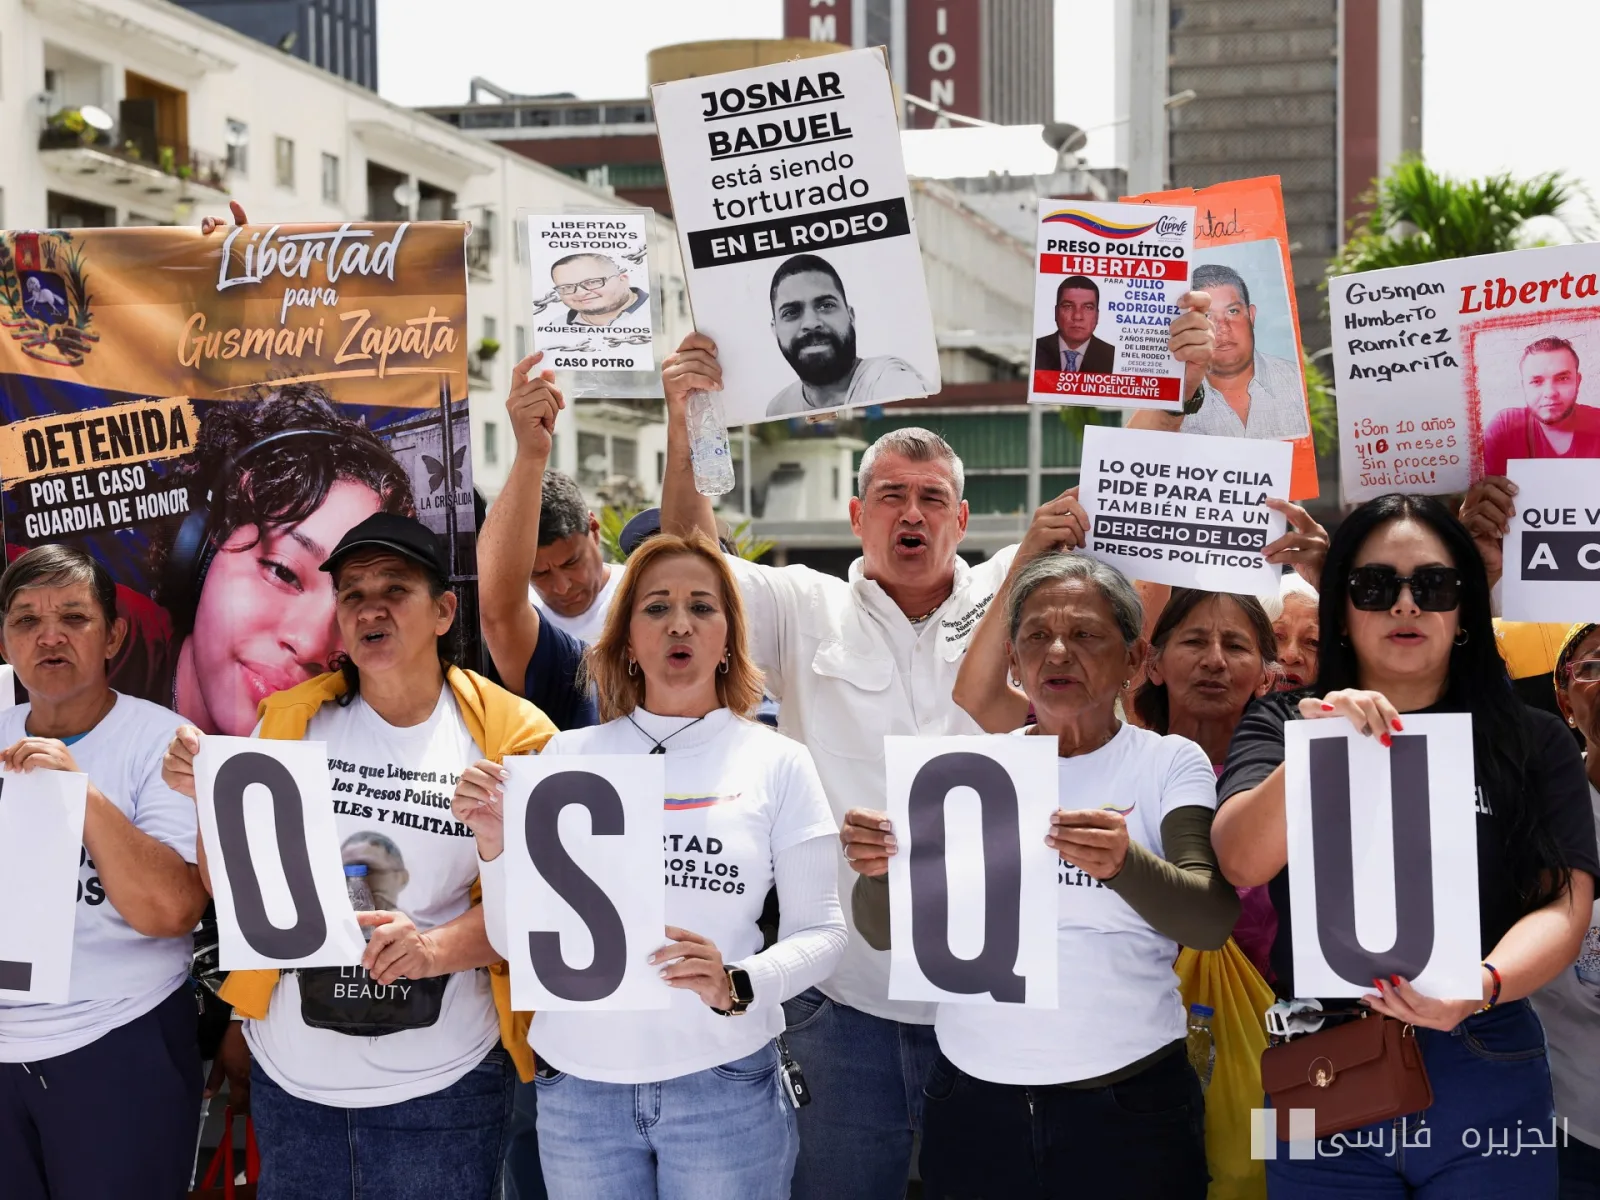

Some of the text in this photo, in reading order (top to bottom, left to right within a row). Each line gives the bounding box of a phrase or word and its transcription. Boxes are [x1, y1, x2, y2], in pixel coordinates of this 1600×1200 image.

[701, 71, 842, 118] JOSNAR
[708, 112, 851, 156] BADUEL
[711, 150, 854, 190] está siendo
[712, 175, 869, 221] torturado
[541, 231, 638, 240] PARA DENYS
[551, 221, 626, 230] LIBERTAD
[710, 212, 888, 258] EN EL RODEO
[548, 241, 631, 249] CUSTODIO.
[1047, 239, 1184, 258] PRESO POLÍTICO
[216, 222, 410, 291] Libertad
[1062, 256, 1166, 278] LIBERTAD
[1127, 279, 1164, 289] JULIO
[1346, 282, 1445, 305] Gusman
[1458, 271, 1599, 315] Liberta
[280, 286, 339, 324] para
[1124, 291, 1165, 302] CESAR
[1108, 302, 1181, 315] RODRIGUEZ
[537, 326, 651, 334] #QUESEANTODOS
[1116, 314, 1171, 326] SALAZAR
[1133, 327, 1171, 336] V-7.575.65
[177, 307, 459, 379] Gusmari Zapata
[1135, 344, 1168, 352] LIBERTAD
[554, 358, 634, 367] CASO POTRO
[1121, 366, 1155, 374] SEPTIEMBRE
[1056, 382, 1160, 397] SOY UN DELICUENTE
[1058, 373, 1159, 387] SOY INOCENTE. NO
[1396, 420, 1415, 434] 10
[1421, 417, 1456, 431] años
[22, 405, 190, 473] DETENIDA
[1396, 435, 1457, 451] meses
[1099, 459, 1273, 487] LO QUE HOY CILIA
[1394, 455, 1460, 473] proceso
[30, 465, 146, 507] POR EL CASO
[1098, 478, 1269, 507] PIDE PARA ELLA
[25, 487, 190, 538] GUARDIA DE HONOR
[420, 497, 432, 510] LA
[1097, 498, 1270, 525] TAMBIÉN ERA UN
[1522, 508, 1577, 529] QUE
[1096, 520, 1264, 548] DERECHO DE LOS
[1094, 542, 1264, 569] PRESOS POLÍTICOS
[1527, 543, 1559, 570] A
[359, 764, 385, 779] que
[387, 763, 437, 782] Liberen
[440, 773, 447, 785] a
[332, 778, 354, 793] los
[356, 782, 401, 802] Presos
[376, 808, 390, 822] Y
[213, 751, 327, 960] O
[1309, 734, 1435, 988] U
[704, 861, 739, 878] LOS
[908, 752, 1026, 1004] Q
[525, 770, 627, 1001] S
[334, 983, 412, 1000] BEAUTY
